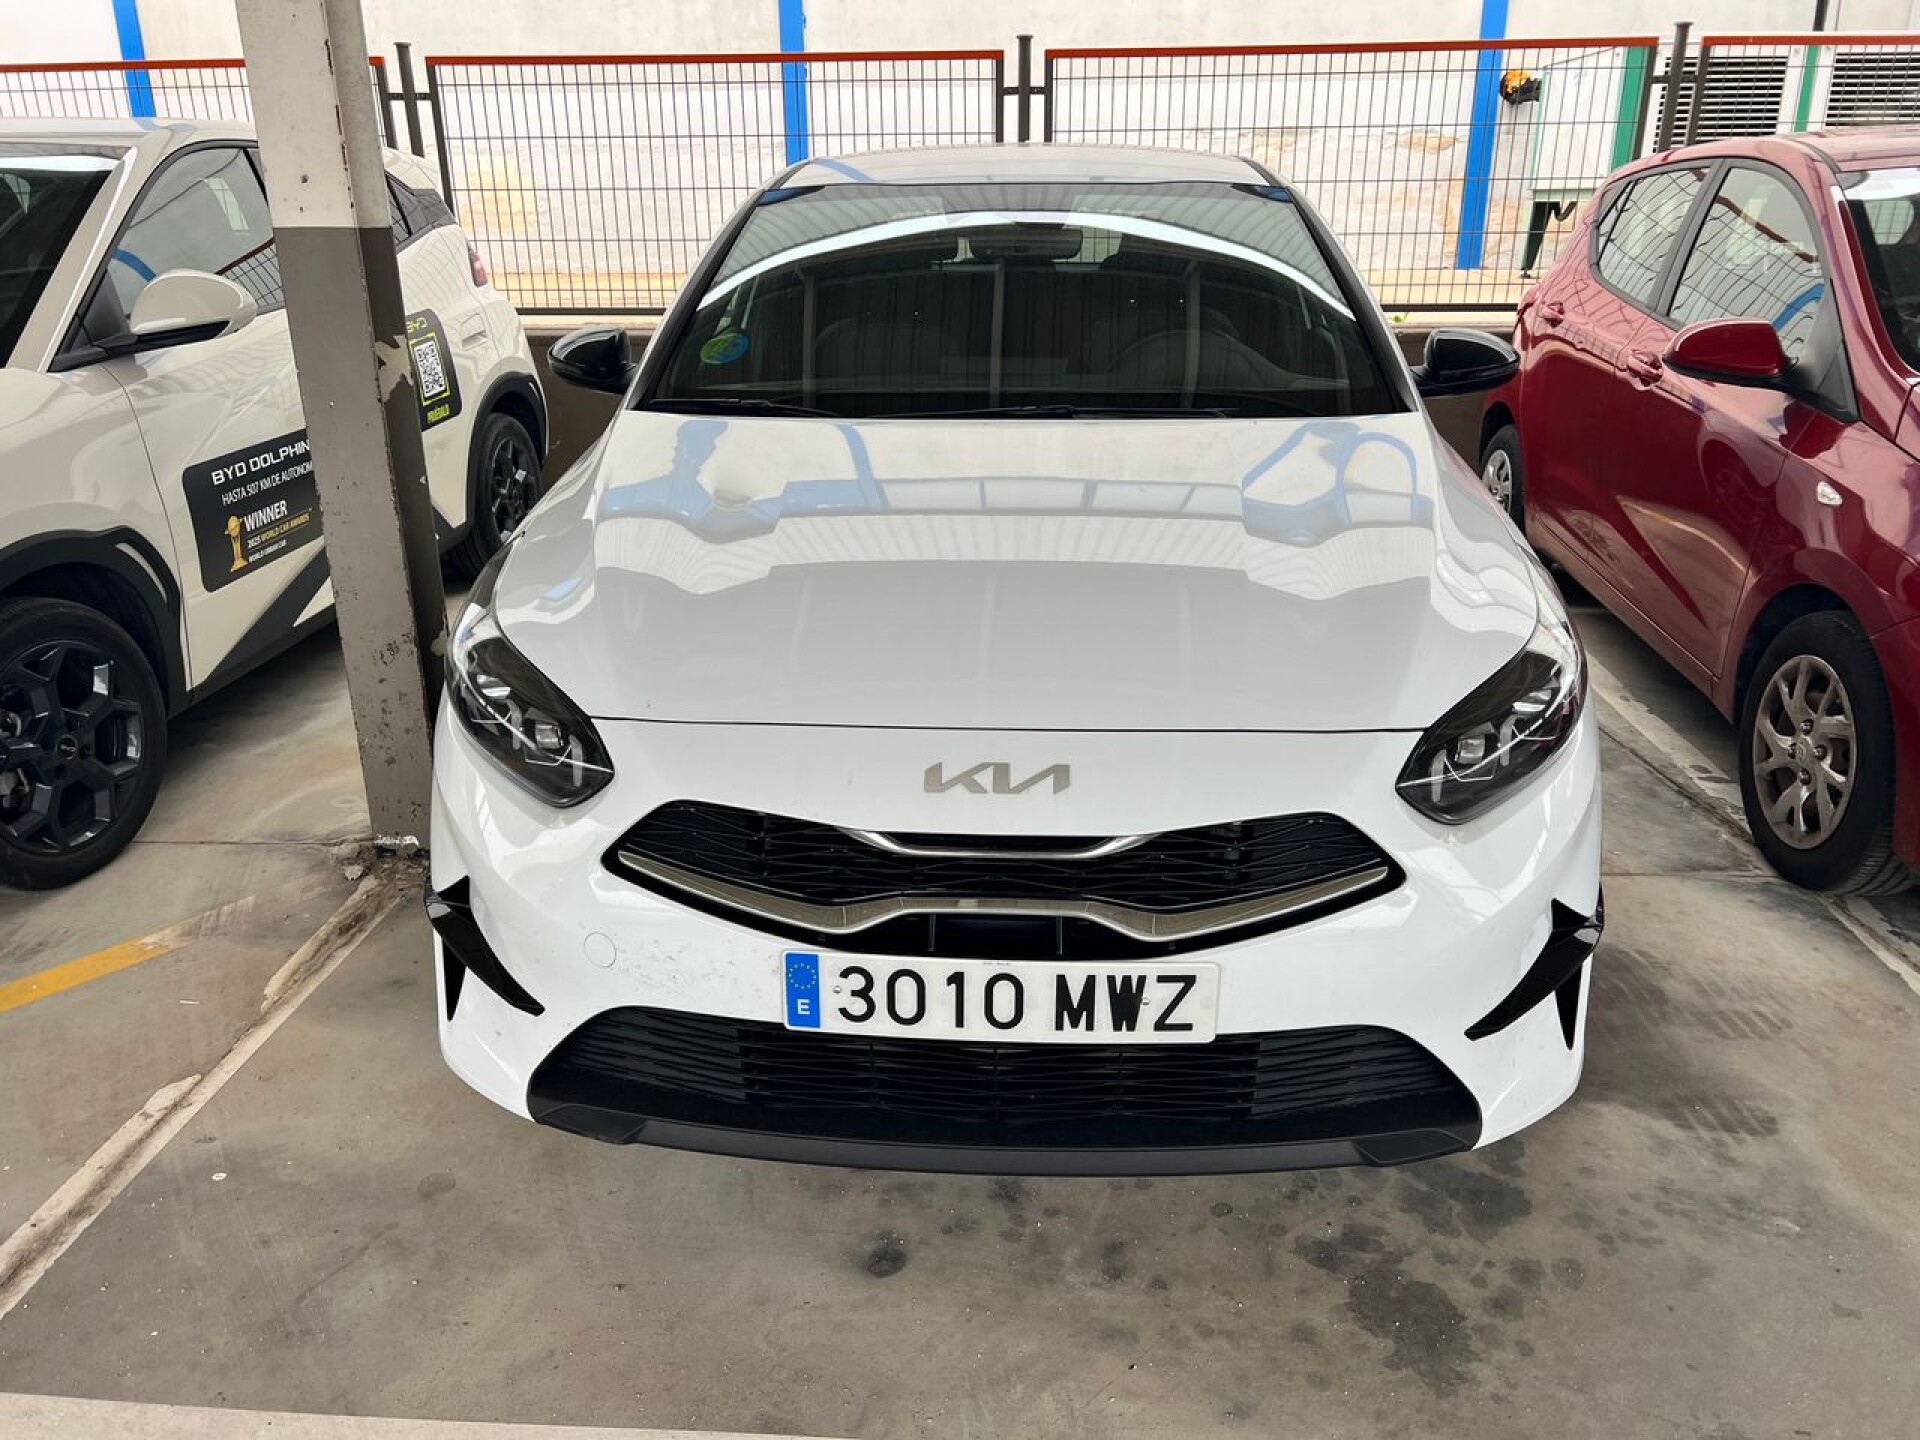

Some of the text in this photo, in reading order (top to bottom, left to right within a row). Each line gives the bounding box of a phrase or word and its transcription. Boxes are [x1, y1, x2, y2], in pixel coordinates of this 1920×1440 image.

[211, 439, 310, 485] BYD DOLPHIN
[221, 486, 247, 506] HASTA
[246, 481, 259, 496] 507
[271, 473, 281, 487] DE
[243, 500, 288, 532] WINNER
[924, 762, 1070, 794] KIA
[797, 998, 811, 1015] E
[838, 965, 1197, 1032] 3010 MWZ
